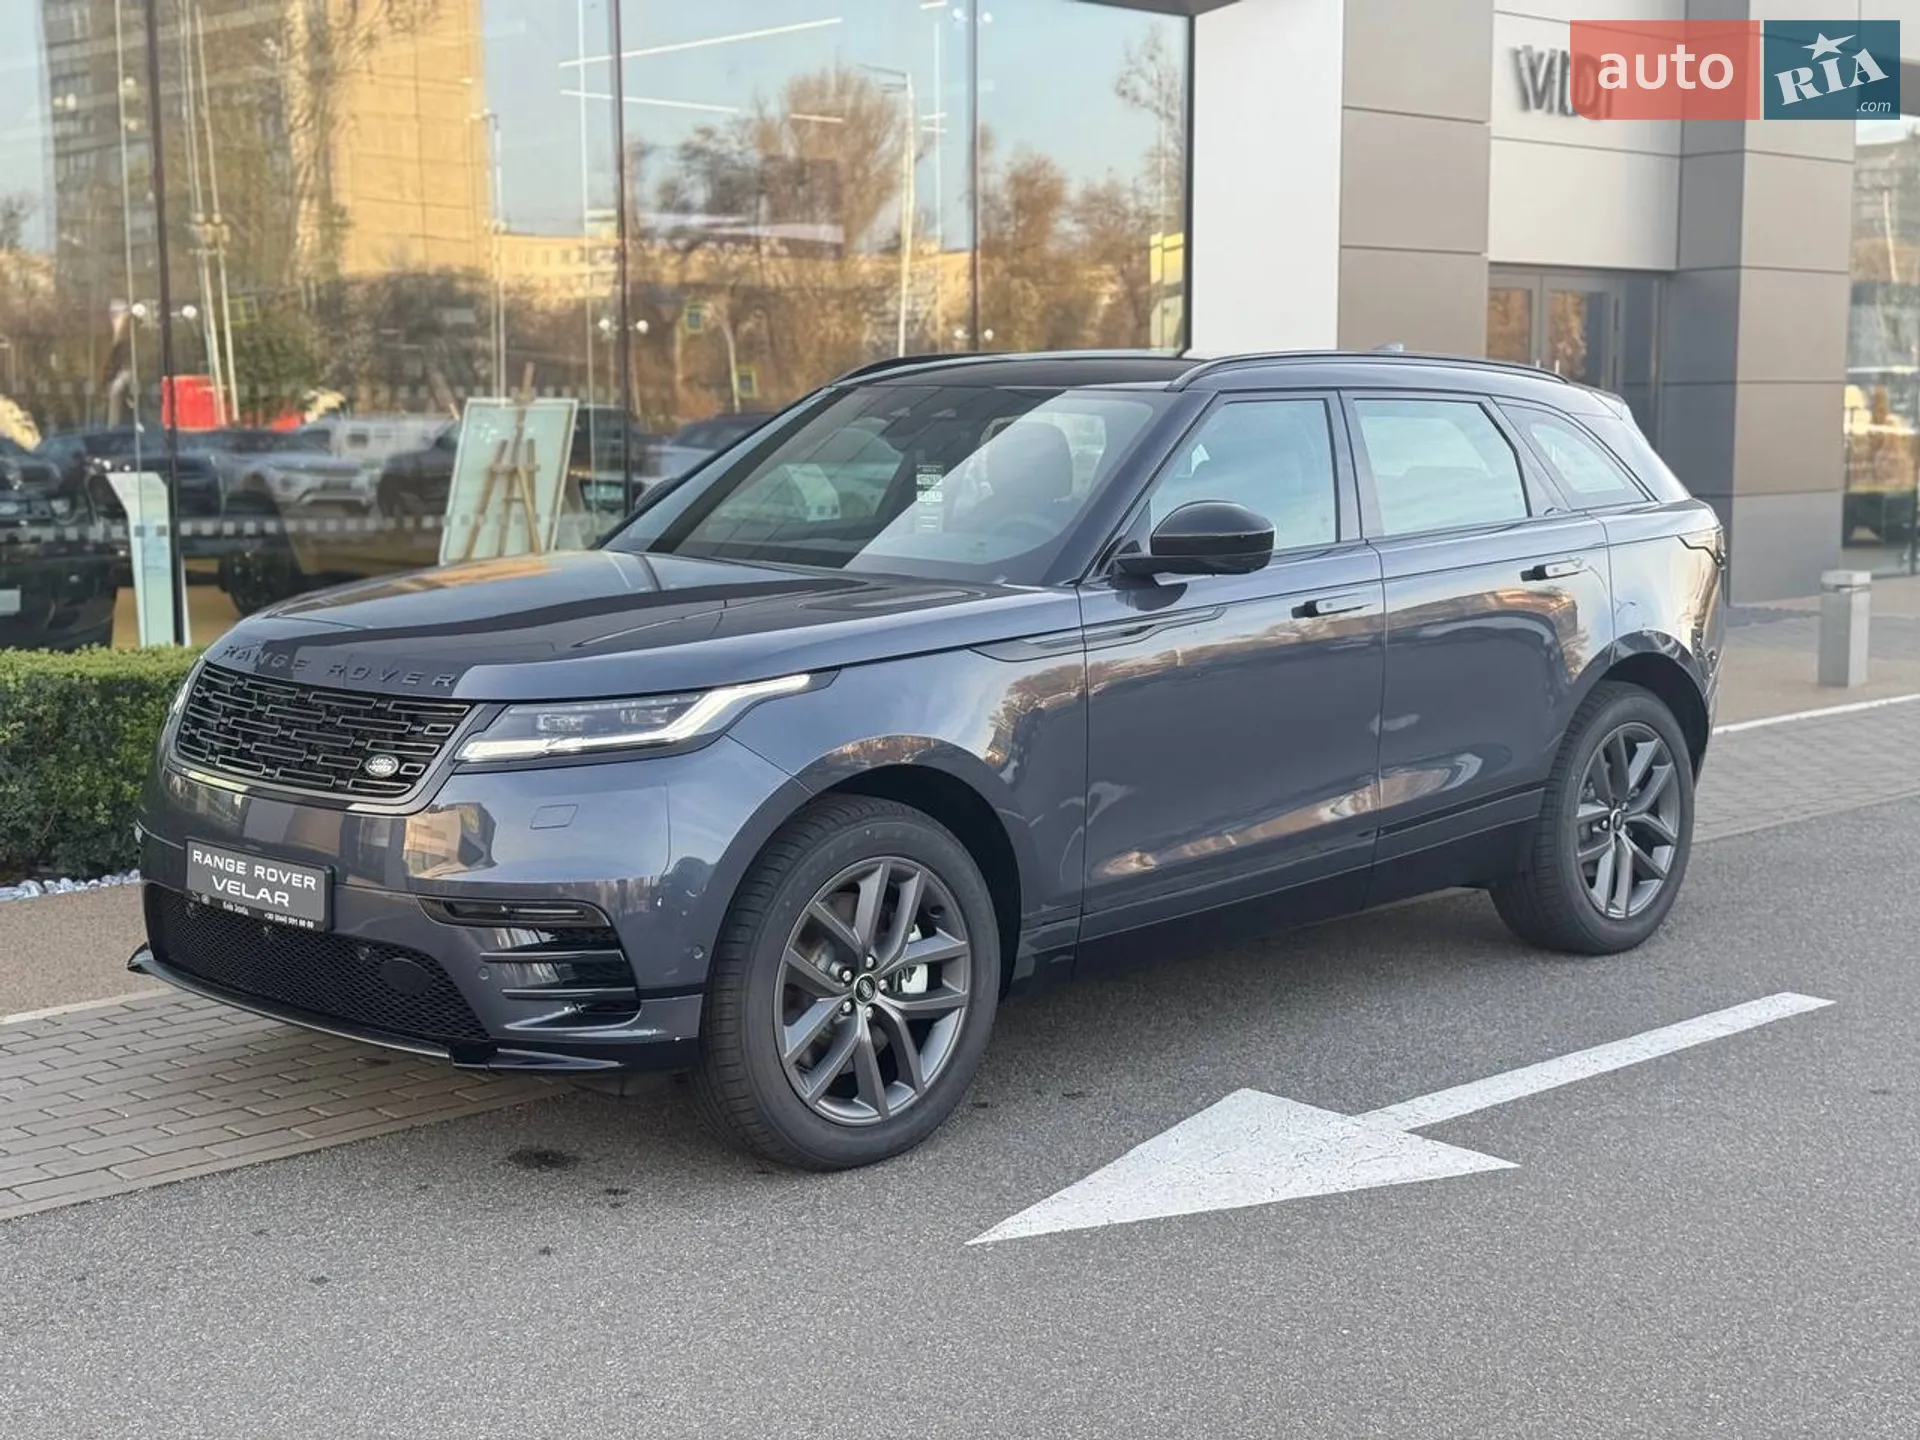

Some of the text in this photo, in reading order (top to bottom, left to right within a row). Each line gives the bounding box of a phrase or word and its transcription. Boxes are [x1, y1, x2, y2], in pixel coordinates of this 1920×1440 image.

[326, 664, 457, 688] ROVER
[192, 849, 317, 891] RANGE ROVER
[212, 875, 290, 908] VELAR
